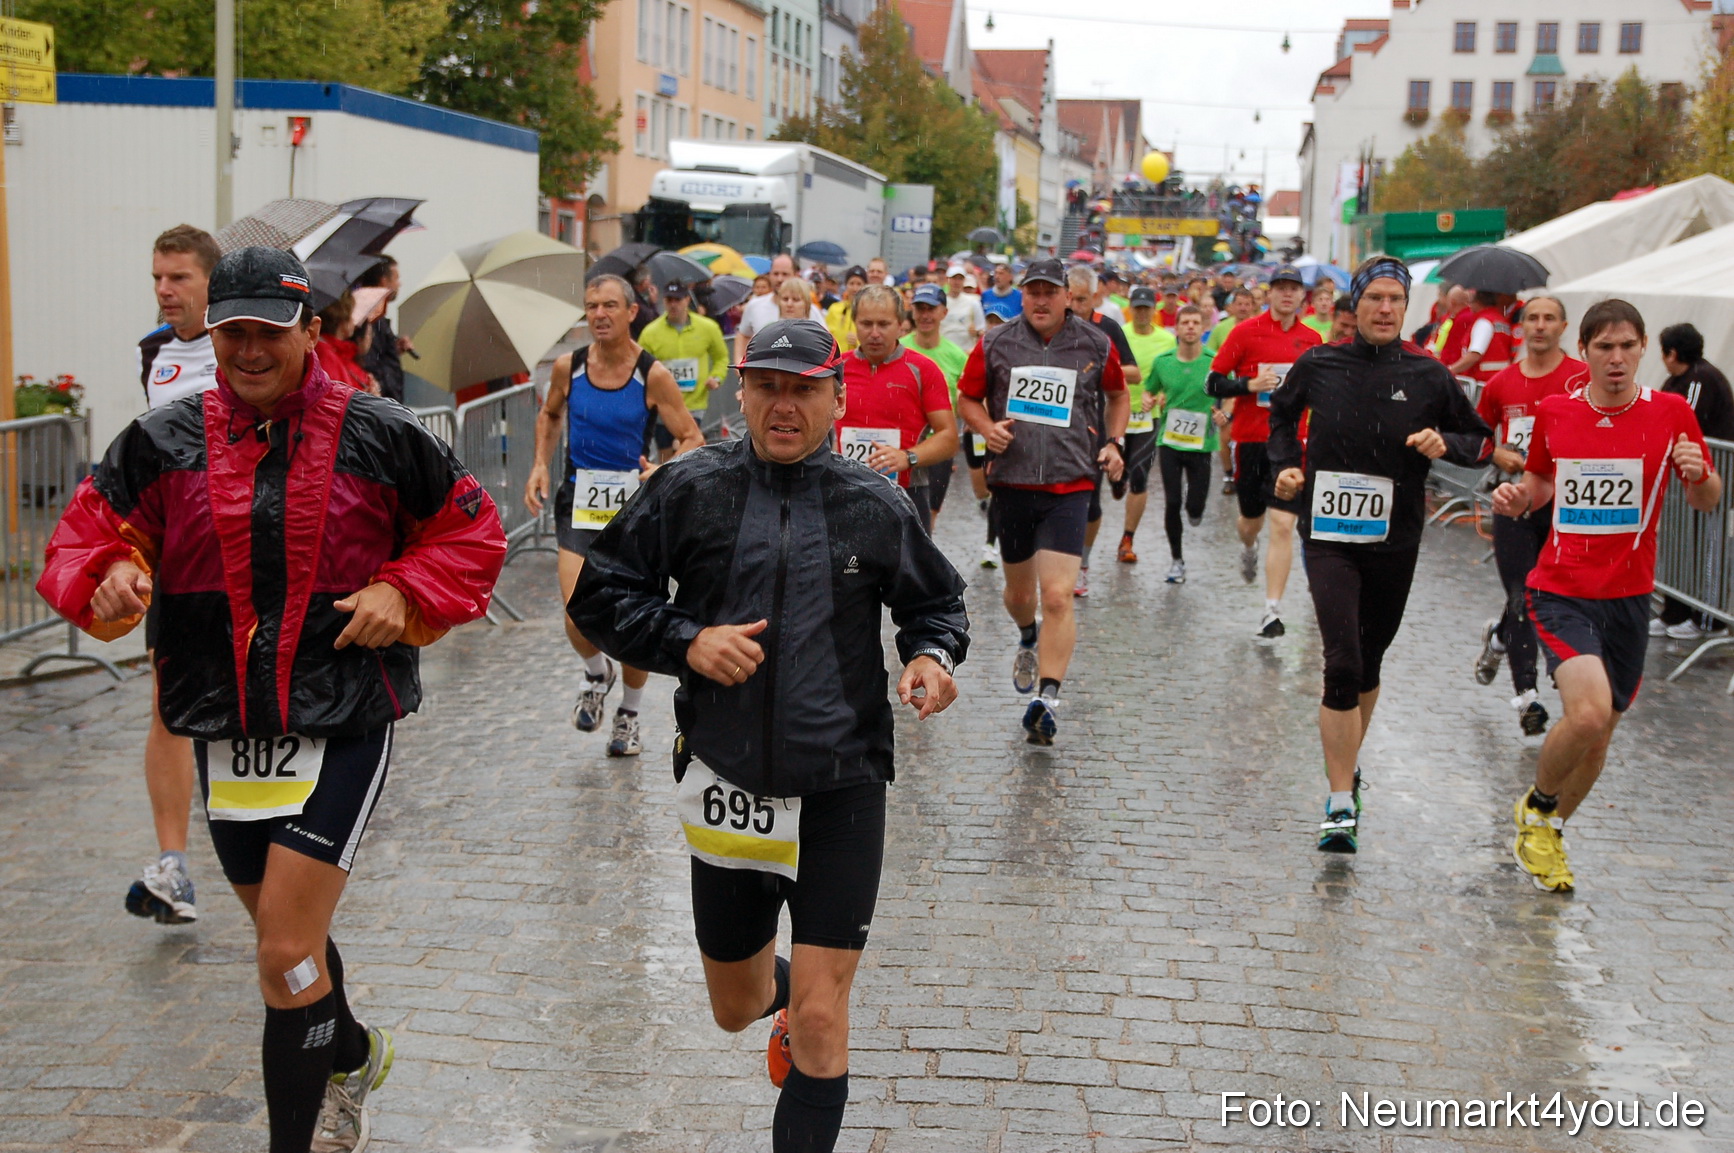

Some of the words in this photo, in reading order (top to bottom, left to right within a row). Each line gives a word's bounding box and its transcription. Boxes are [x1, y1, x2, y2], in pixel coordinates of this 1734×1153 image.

[1141, 221, 1180, 231] START
[668, 367, 694, 380] 641
[1015, 377, 1067, 405] 2250
[1023, 404, 1053, 417] Helmut
[1173, 419, 1198, 436] 272
[587, 486, 627, 508] 214
[1564, 479, 1634, 506] 3422
[1321, 490, 1384, 517] 3070
[1565, 509, 1629, 523] DANIEL
[1337, 521, 1363, 533] Peter
[231, 735, 301, 778] 802
[703, 784, 775, 835] 695
